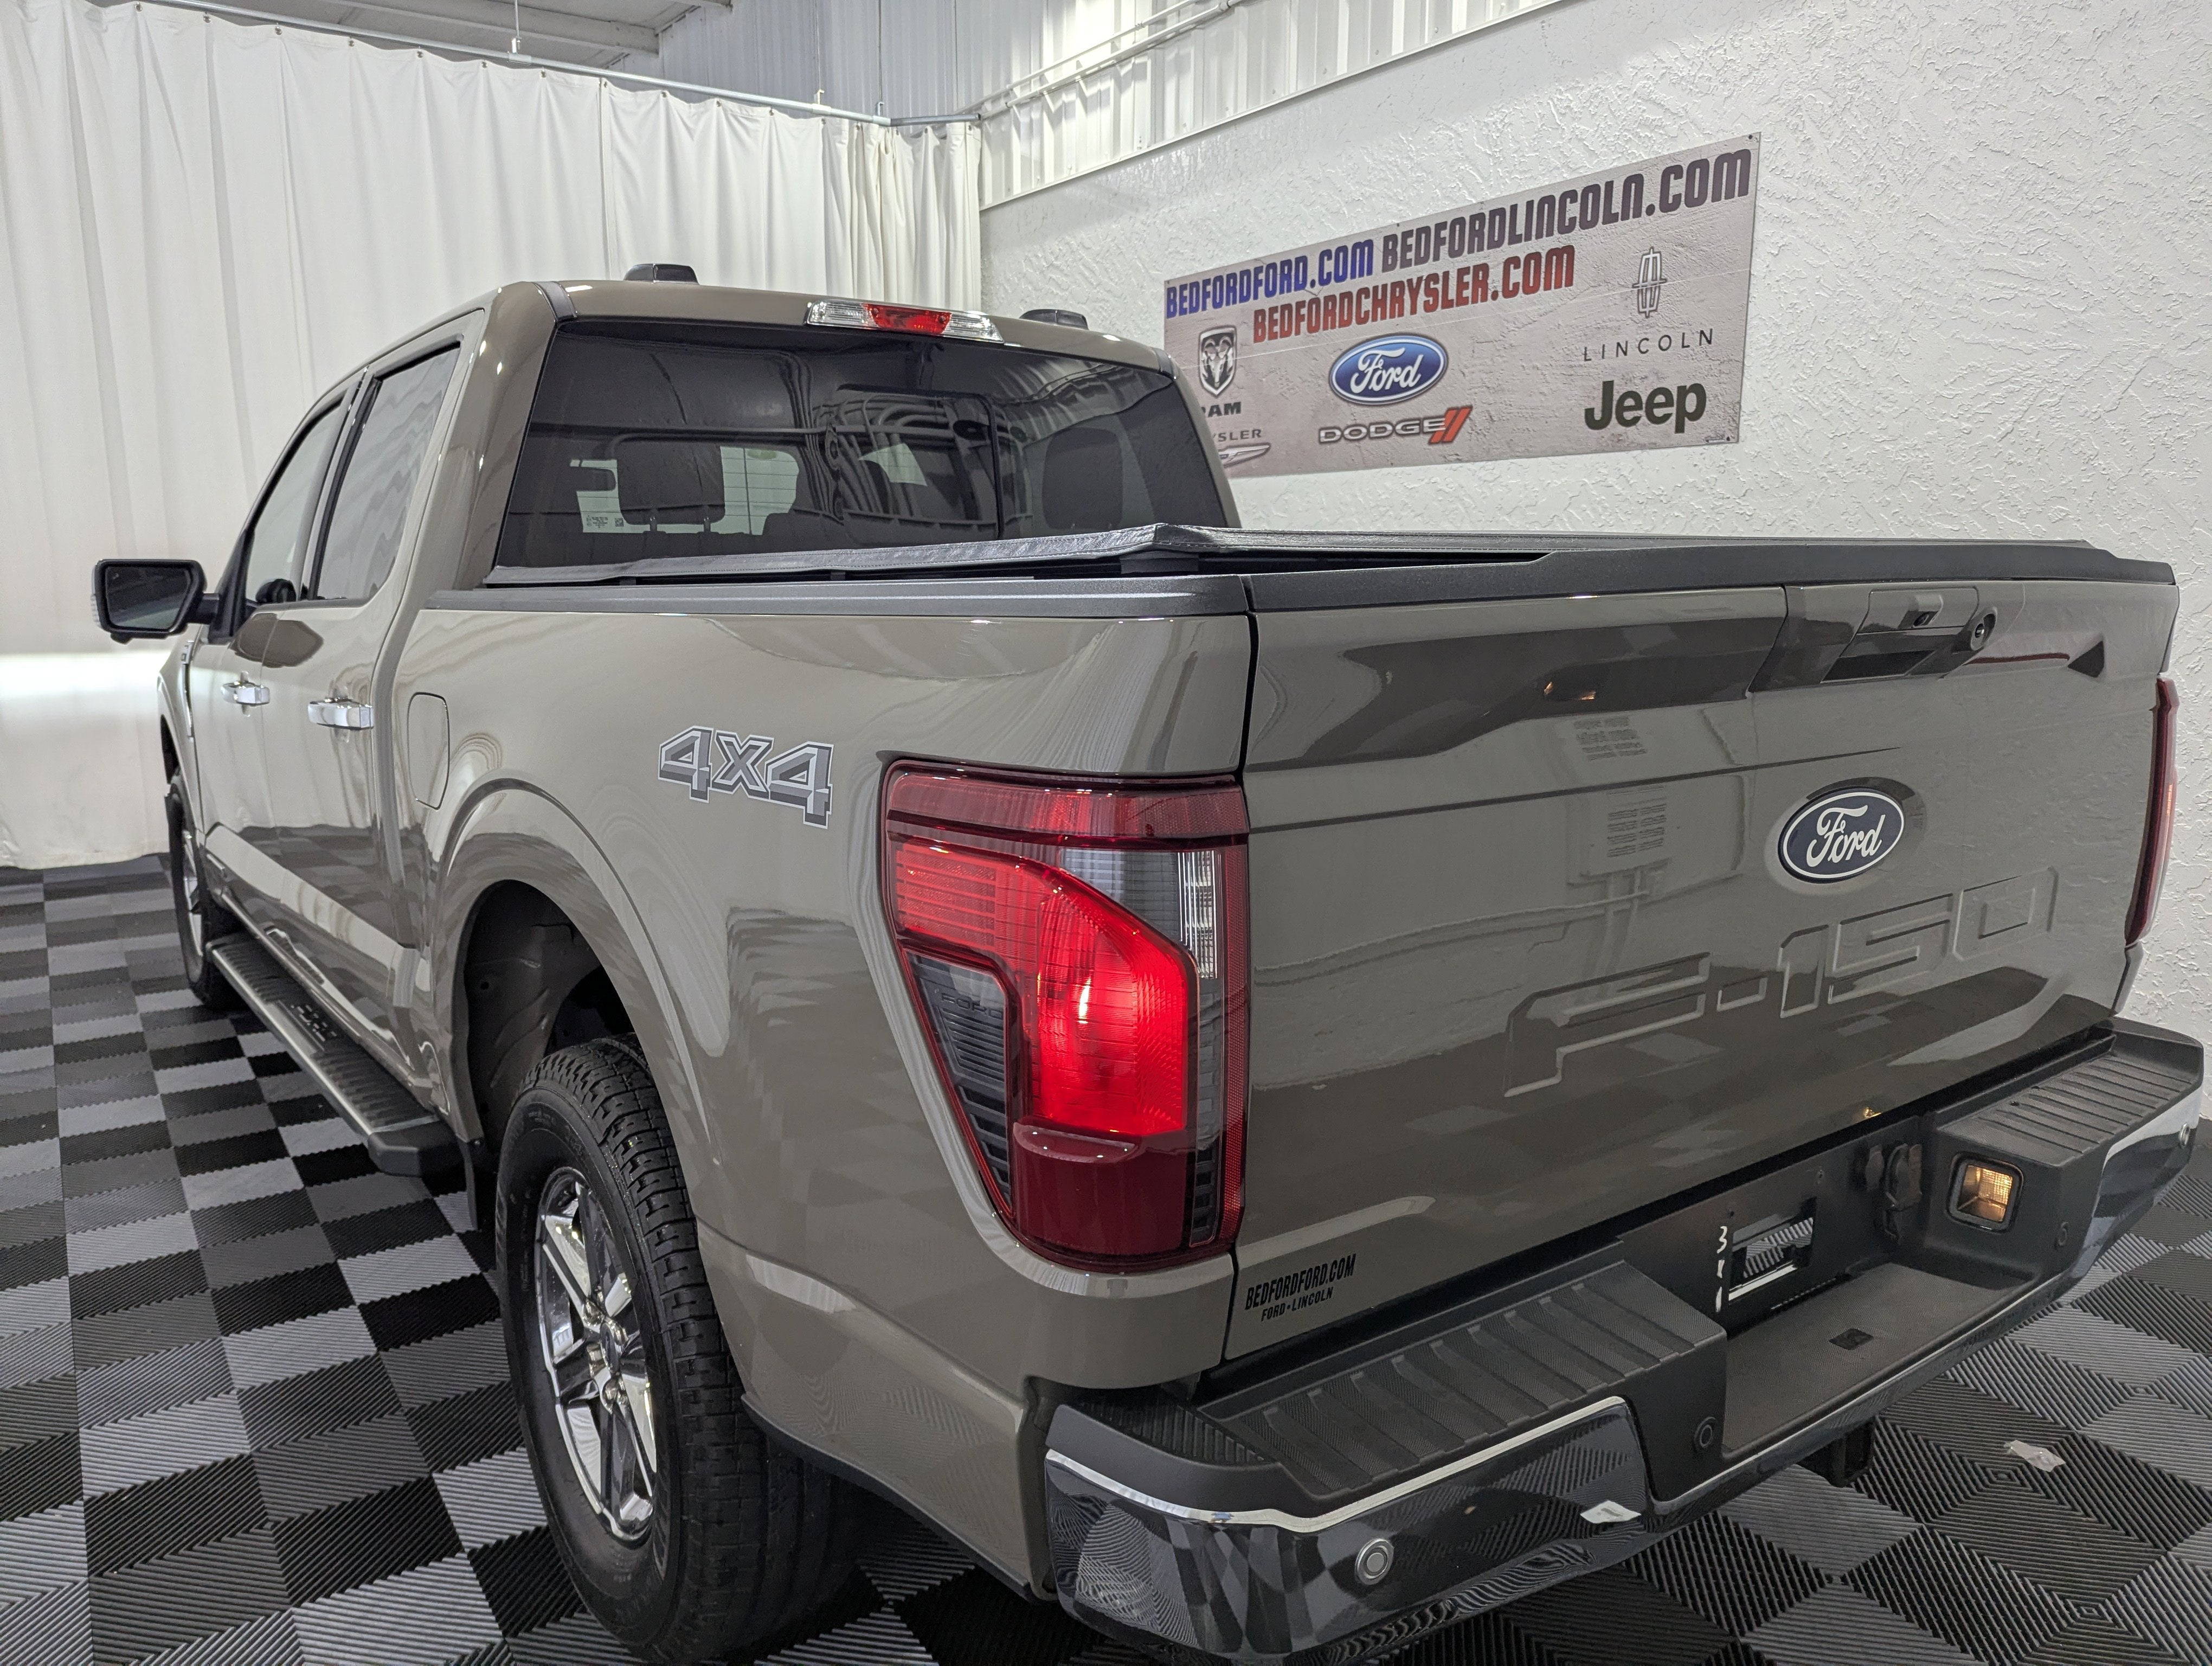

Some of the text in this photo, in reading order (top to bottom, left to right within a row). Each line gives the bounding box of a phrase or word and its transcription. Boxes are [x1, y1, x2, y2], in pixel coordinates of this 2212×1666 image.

[1166, 149, 1752, 319] BEDFORDFORD.COM BEDFORDLINCOLN.COM
[1253, 245, 1575, 344] BEDFORDCHRYSLER.COM
[1349, 347, 1424, 394] Ford
[1584, 328, 1713, 362] LINCOLN
[1201, 401, 1242, 418] AM
[1319, 416, 1446, 444] DODGE
[1584, 380, 1707, 434] Jeep
[1806, 804, 1886, 868] Ford
[1503, 867, 2059, 1098] F-150
[1245, 1253, 1356, 1310] BEDFORDFORD.COM
